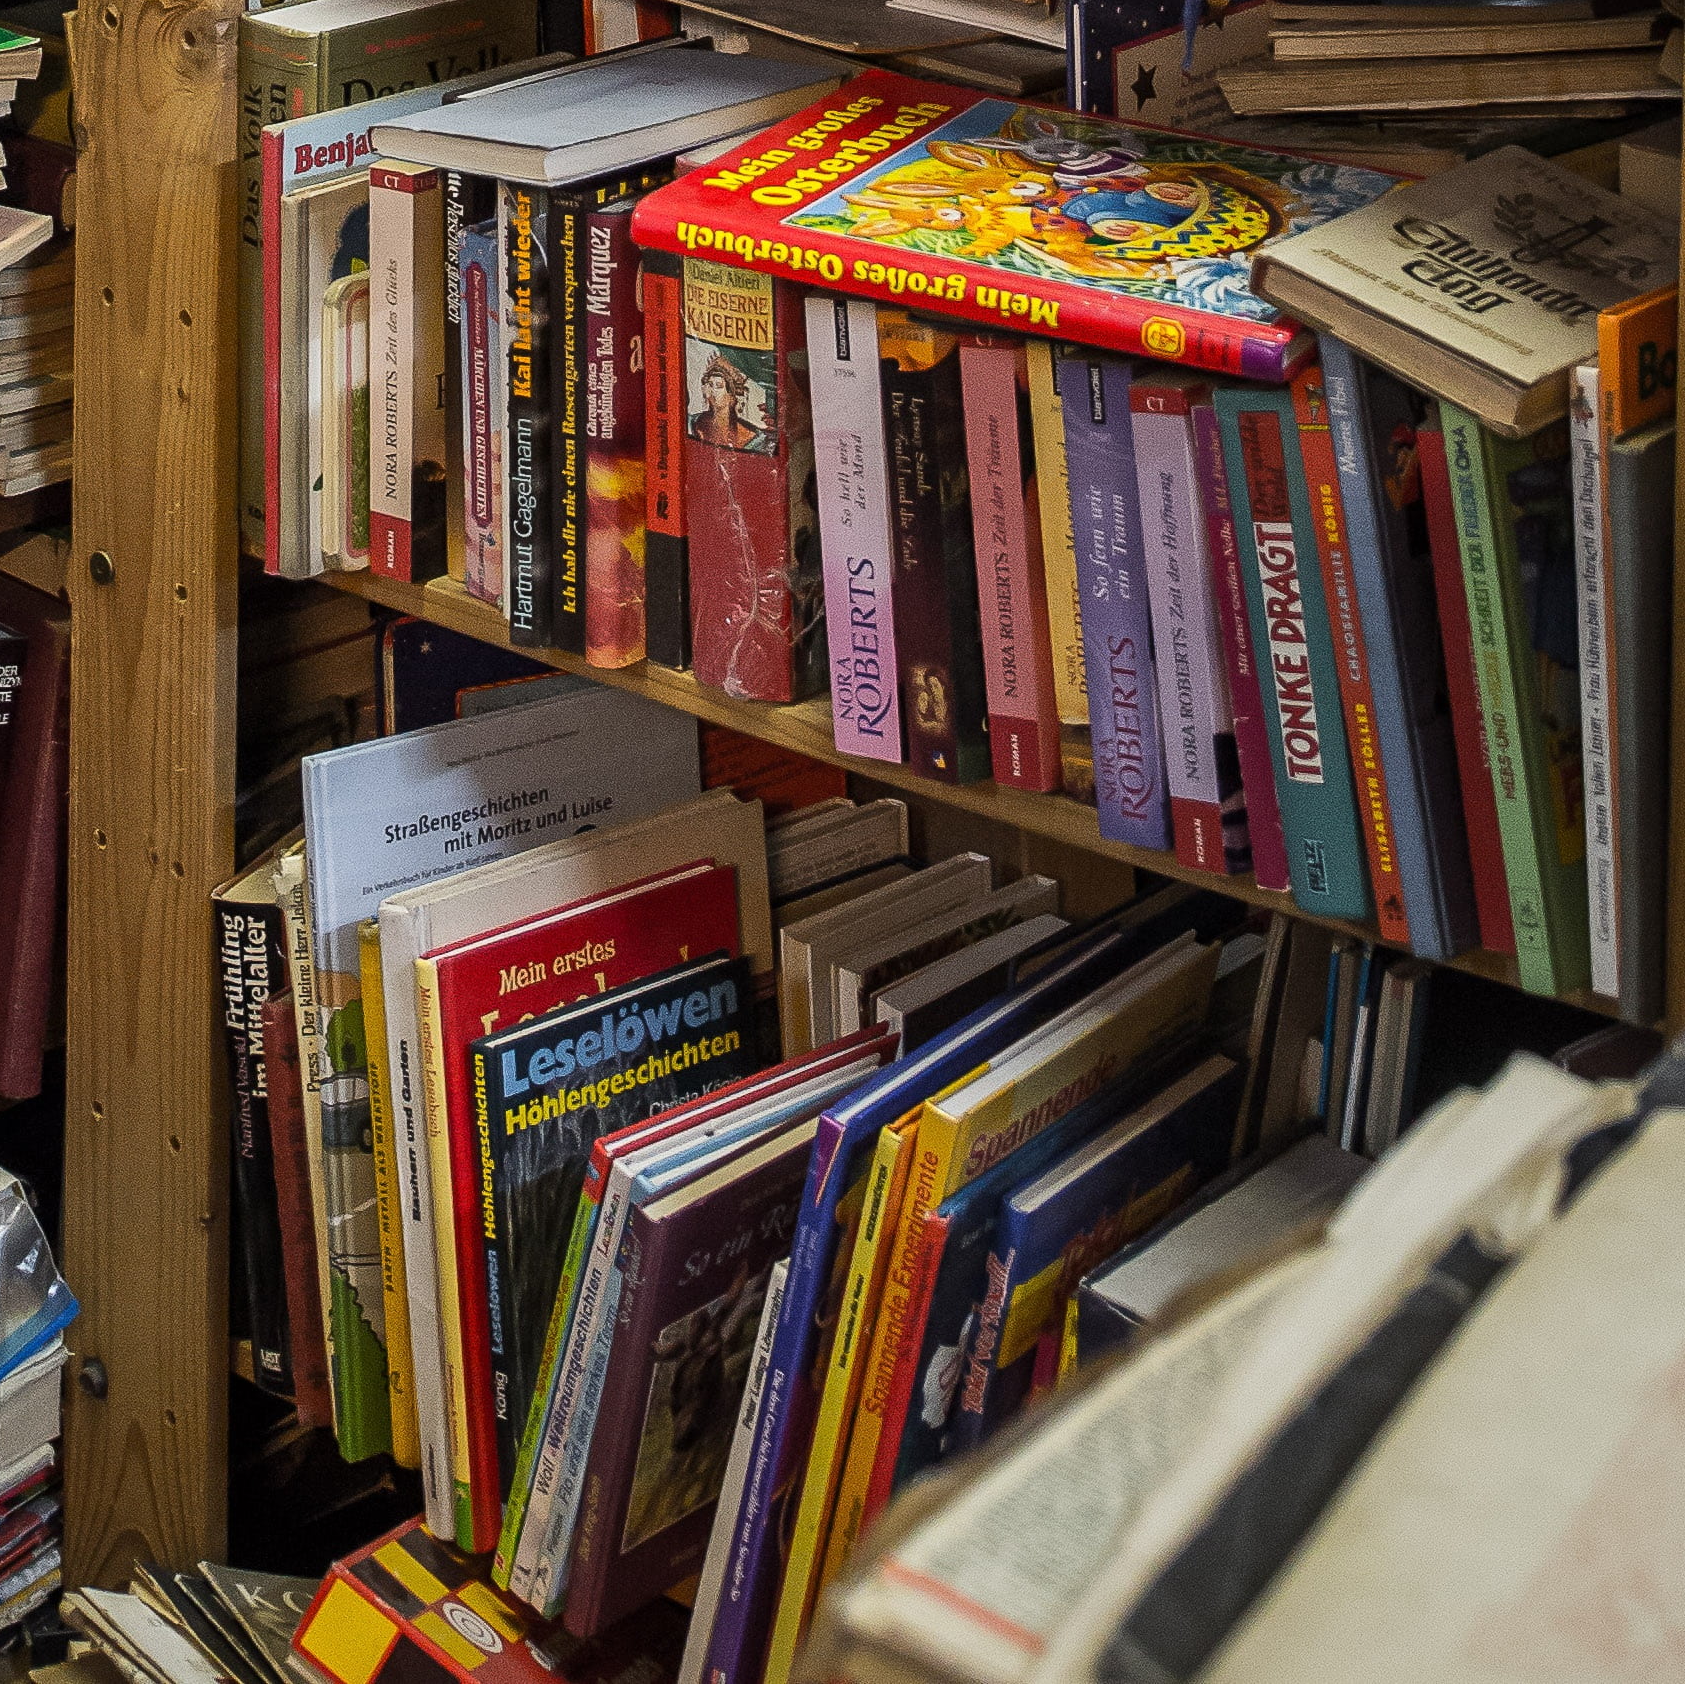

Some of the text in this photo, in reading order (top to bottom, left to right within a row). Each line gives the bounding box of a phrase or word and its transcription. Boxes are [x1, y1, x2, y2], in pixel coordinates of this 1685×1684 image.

[750, 99, 950, 207] Osterbuch
[586, 227, 609, 318] Márquez
[676, 220, 1061, 330] Osterbuch großes Mein
[685, 309, 770, 344] KAISERIN
[514, 191, 539, 632] Hartmut Gagelmann Kai lacht wieder
[836, 556, 881, 739] NORA ROBERTS
[1257, 522, 1323, 784] TONKE DRAGT
[1119, 636, 1148, 823] ROBERTS
[383, 784, 550, 846] Straßengeschichten
[222, 911, 248, 1031] Frühling
[498, 932, 616, 993] Mein erstes
[500, 983, 739, 1098] Leselöwen
[504, 1028, 742, 1136] Höhlengeschichten
[482, 1052, 508, 1420] König Leselöwen Höhlengeschichten
